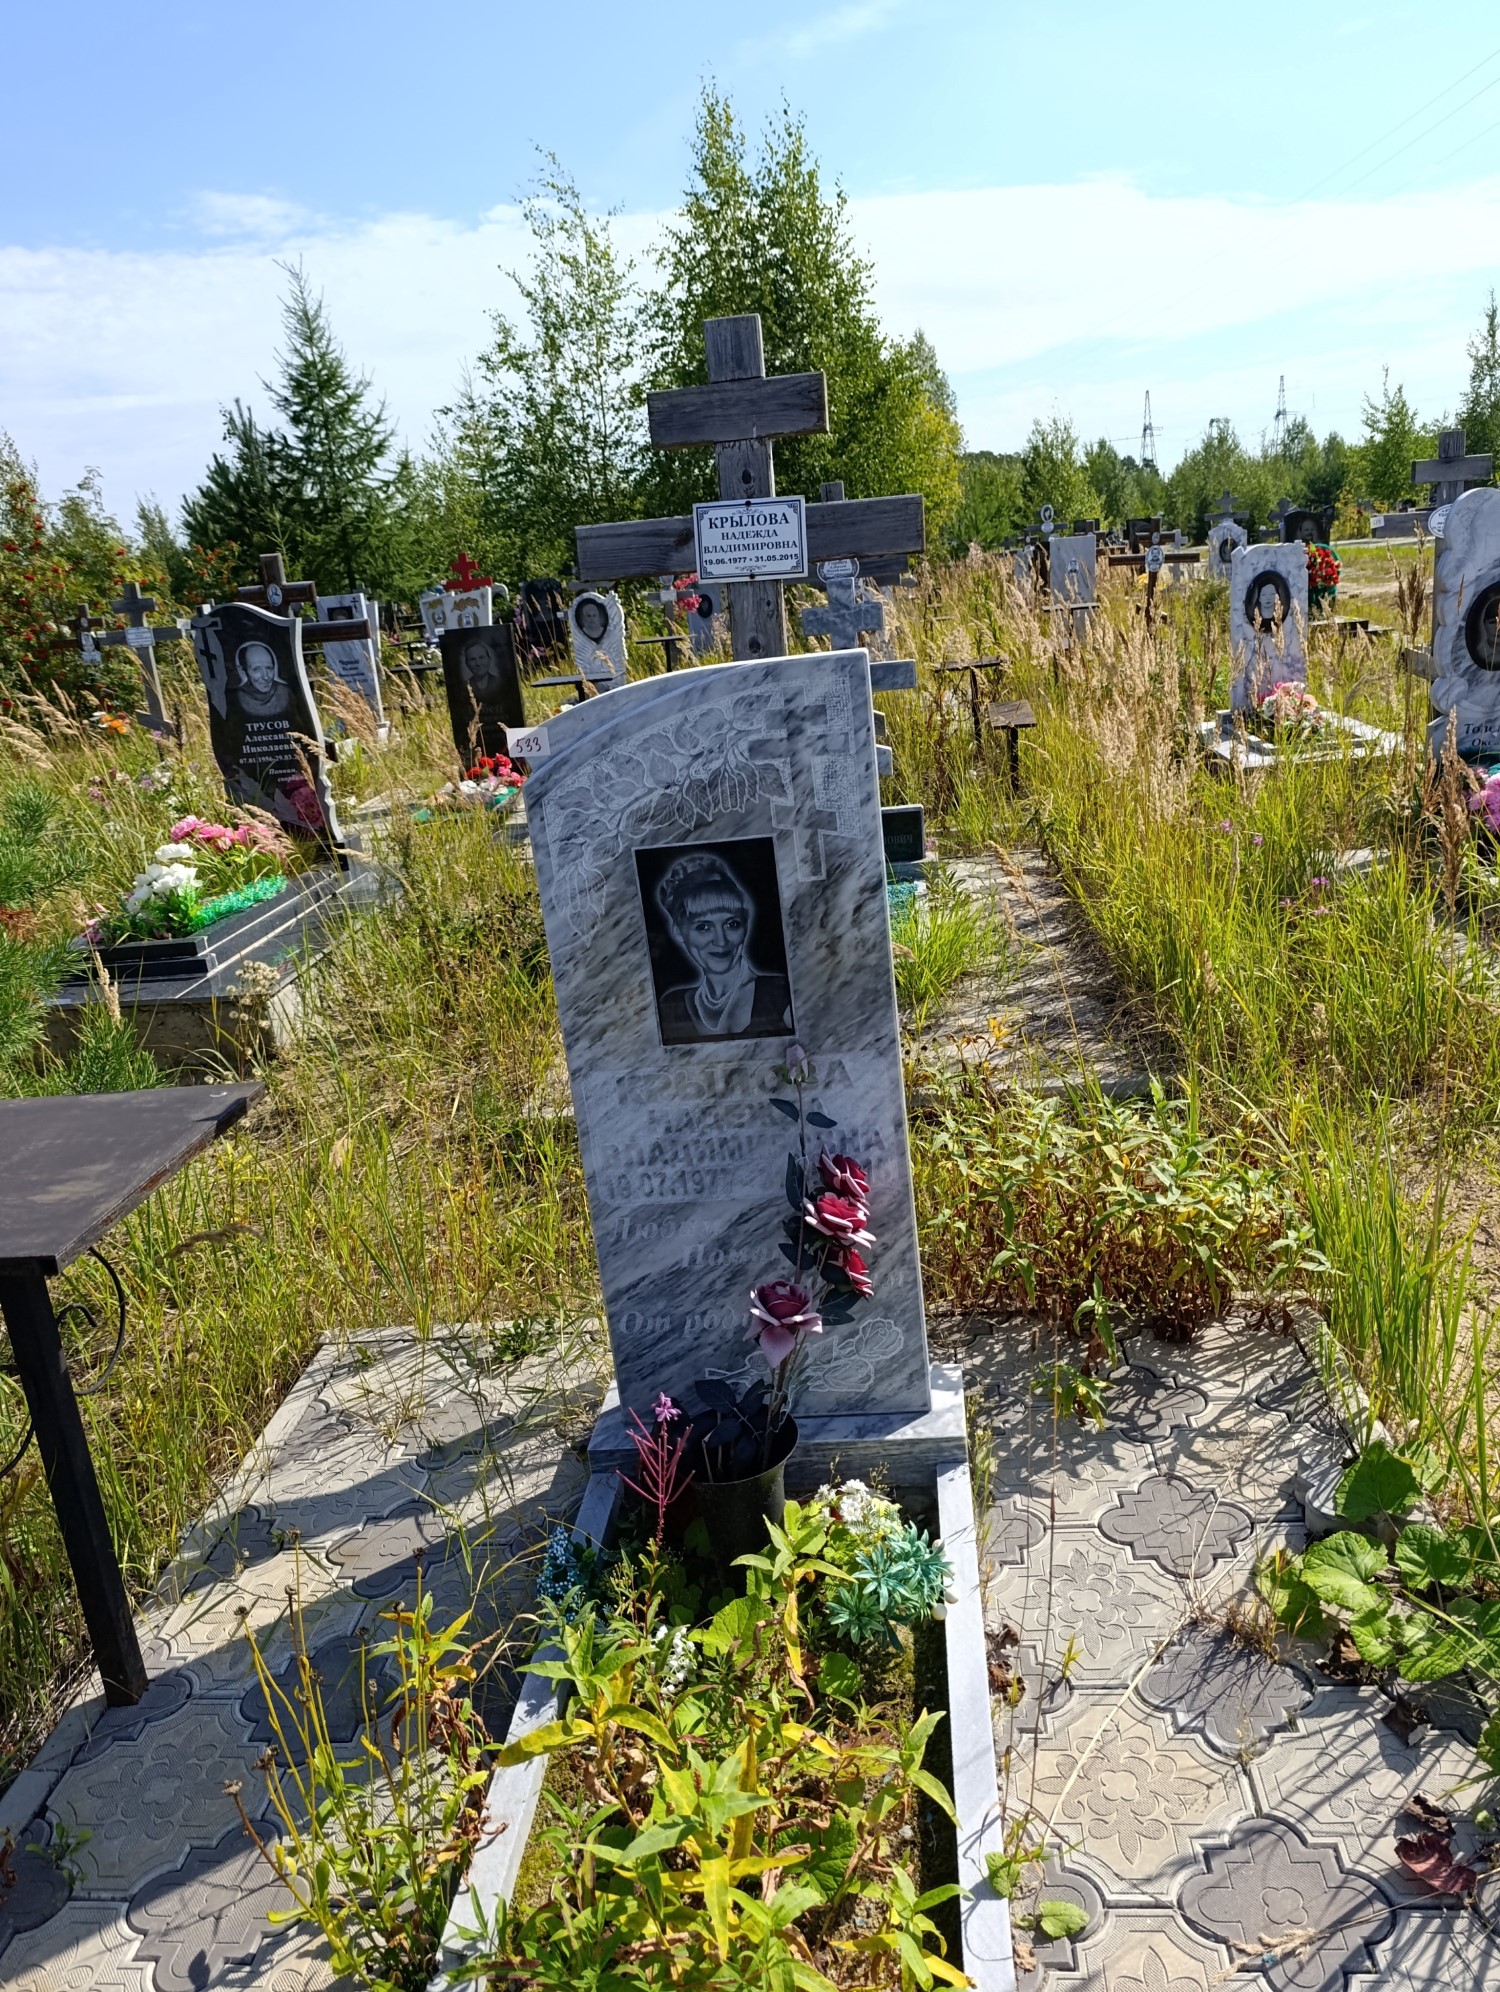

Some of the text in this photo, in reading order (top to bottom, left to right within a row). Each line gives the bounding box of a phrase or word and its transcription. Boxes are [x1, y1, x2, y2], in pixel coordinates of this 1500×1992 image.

[708, 512, 790, 529] КРЫЛОВА
[721, 529, 778, 541] НАДЕЖДА
[703, 540, 798, 554] ВЛАДИМИРОВНА
[704, 553, 799, 566] 19.06.1977 31.05.2015
[245, 720, 290, 732] ТРУСОВ
[515, 736, 542, 753] 533
[615, 1058, 854, 1105] КРЫЛОА
[618, 1310, 672, 1335] От
